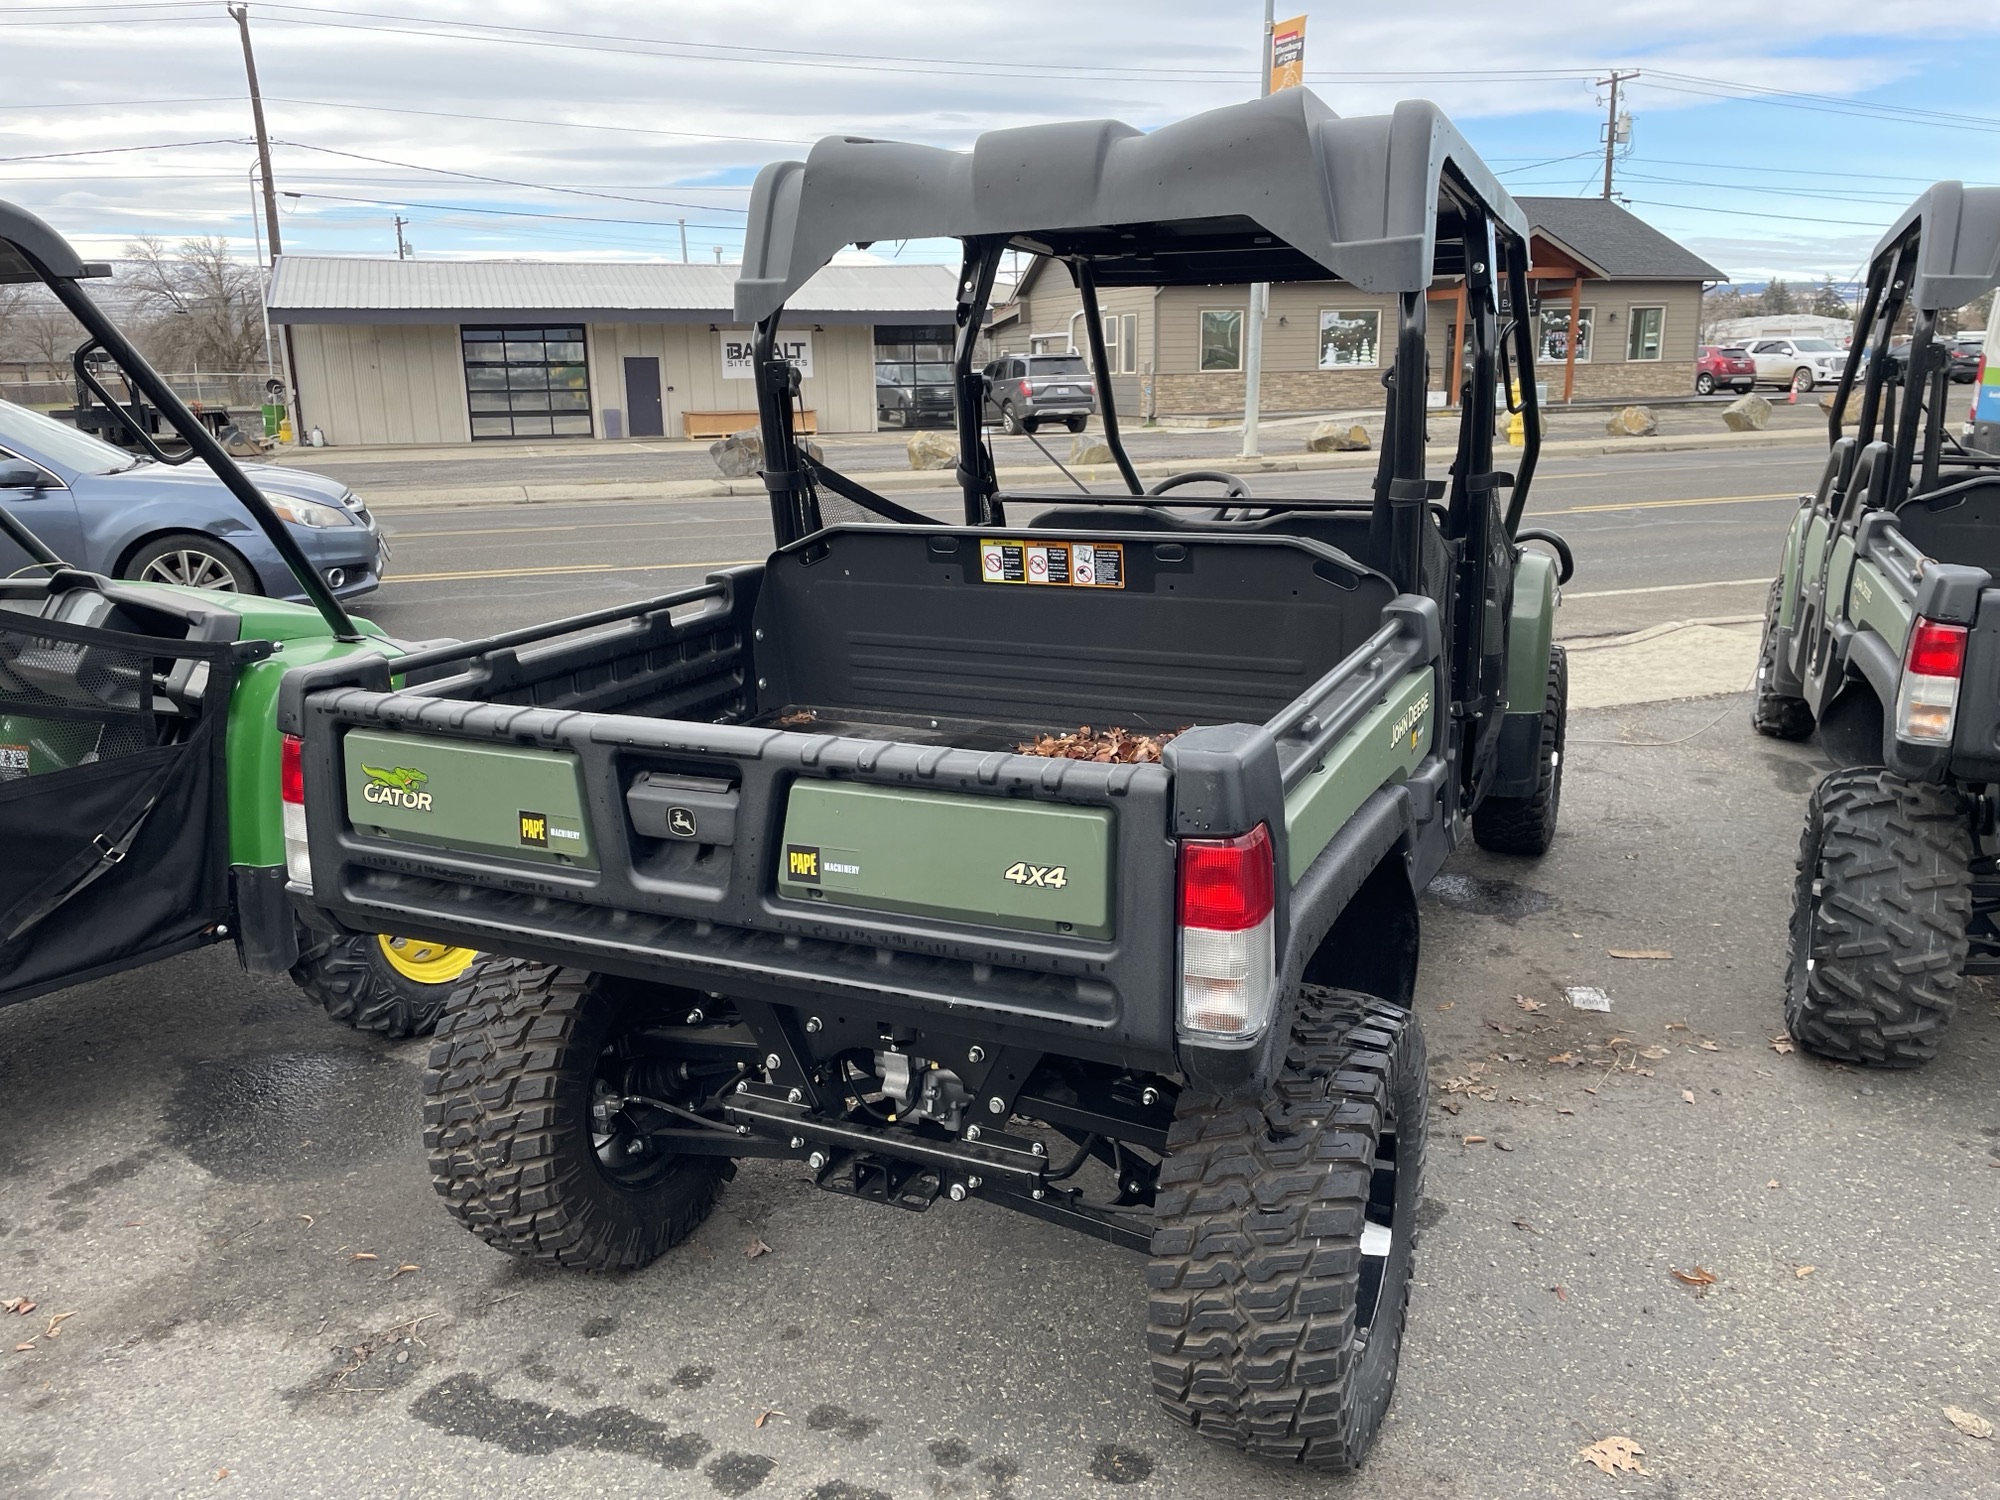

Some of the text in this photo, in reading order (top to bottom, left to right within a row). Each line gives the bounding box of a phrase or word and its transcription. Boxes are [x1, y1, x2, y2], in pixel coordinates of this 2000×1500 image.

[726, 342, 806, 360] BAALT
[1390, 713, 1409, 750] JOHN
[1408, 691, 1430, 729] DEERE
[363, 782, 433, 812] GATOR
[823, 862, 860, 875] MACHINERY
